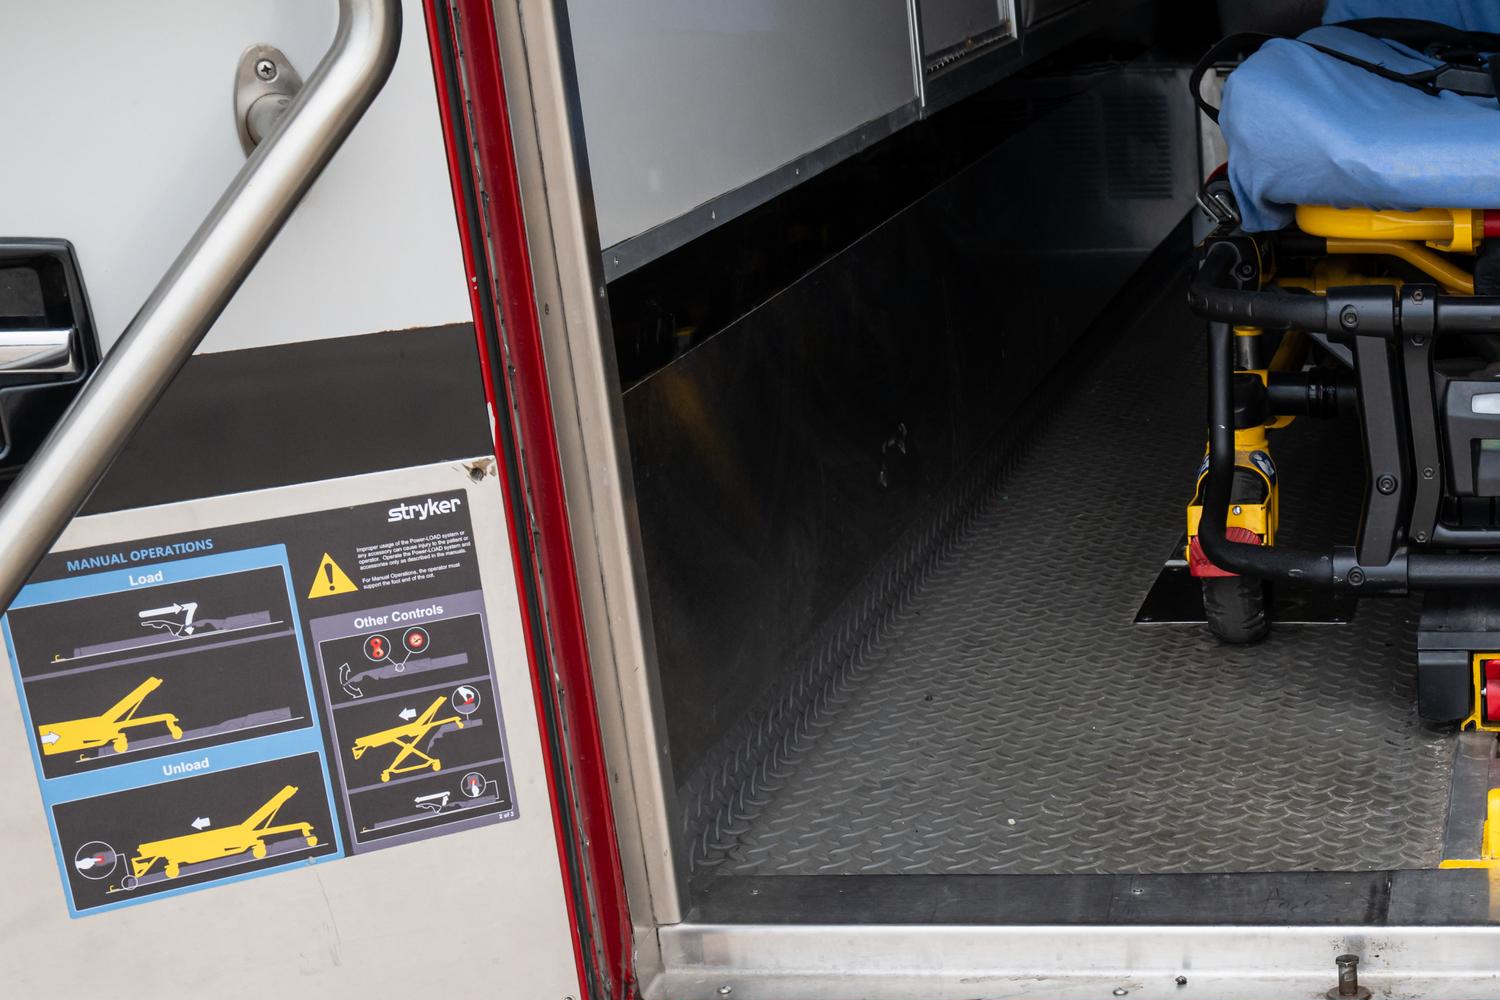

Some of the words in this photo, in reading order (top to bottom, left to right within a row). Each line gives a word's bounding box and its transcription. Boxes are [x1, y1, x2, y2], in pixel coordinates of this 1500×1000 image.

[388, 498, 461, 522] stryker
[356, 545, 378, 553] Improper
[442, 532, 460, 540] system
[444, 543, 461, 552] system
[66, 552, 128, 572] MANUAL
[130, 539, 214, 562] OPERATIONS
[360, 562, 388, 570] accessories
[408, 554, 431, 562] described
[368, 548, 392, 558] accessory
[128, 570, 164, 586] Load
[372, 574, 390, 582] Manual
[428, 564, 448, 573] operator
[354, 615, 388, 629] Other
[391, 604, 444, 622] Controls
[162, 756, 210, 776] Unload
